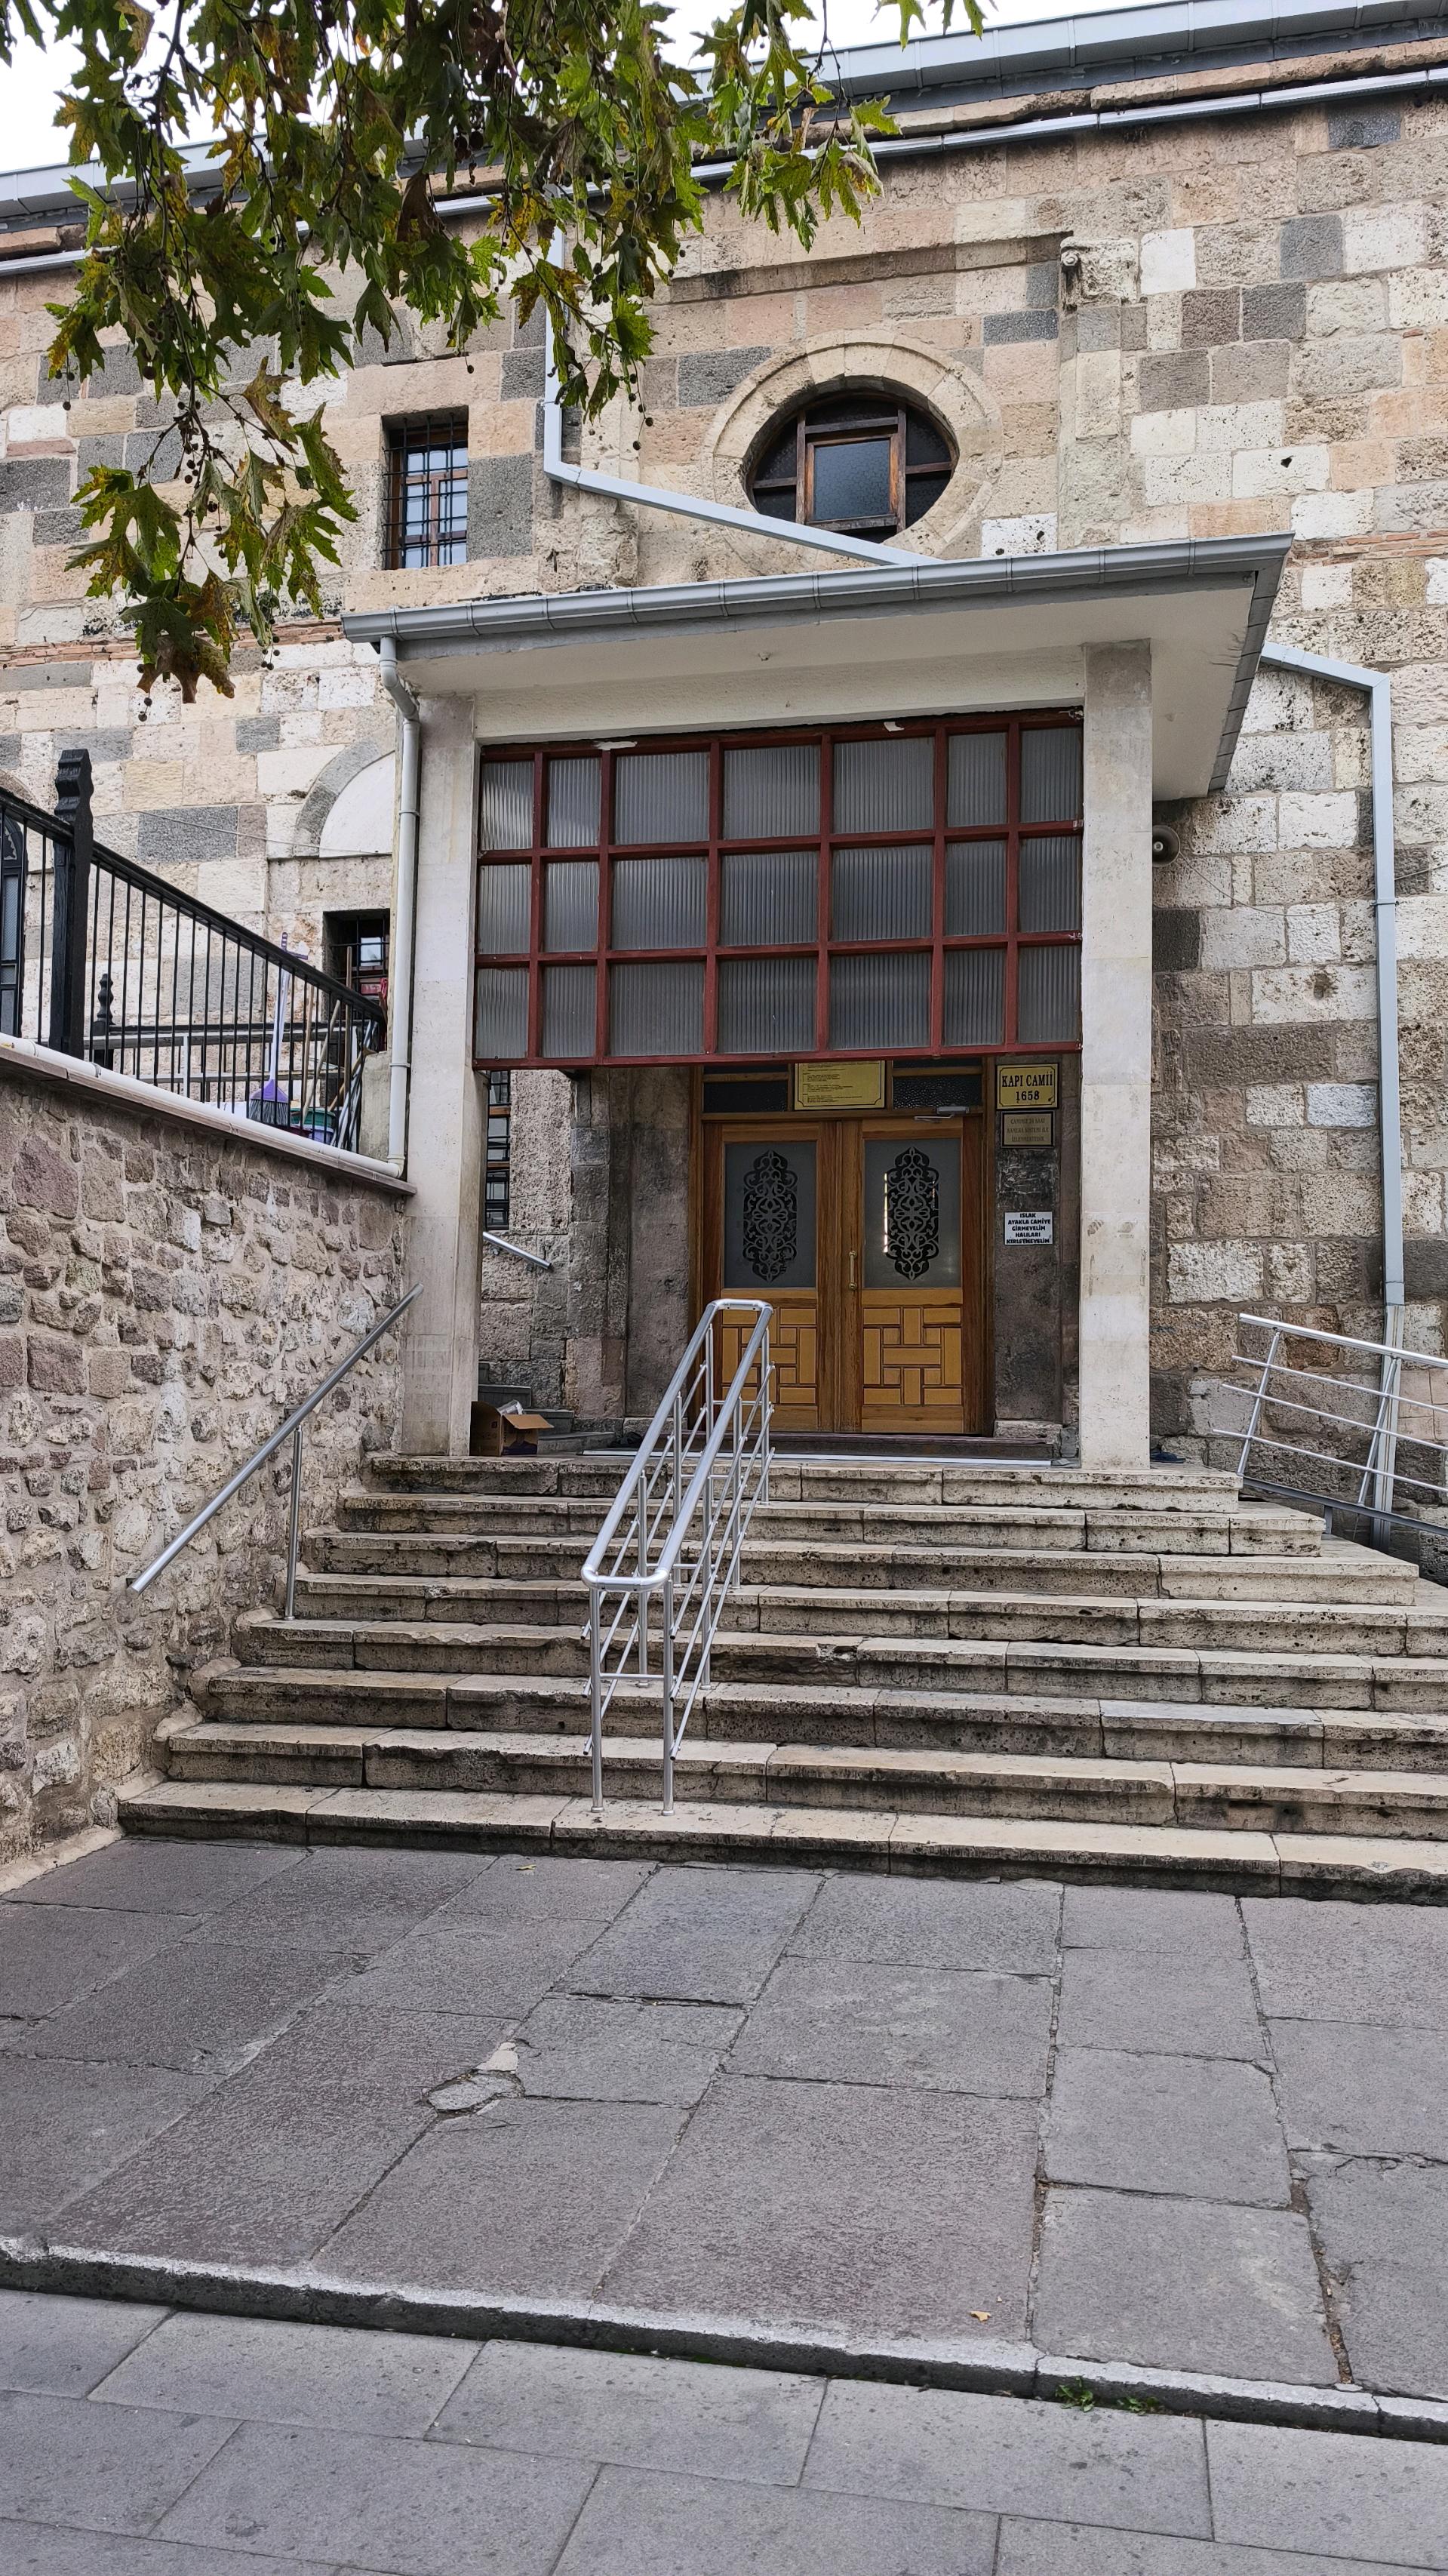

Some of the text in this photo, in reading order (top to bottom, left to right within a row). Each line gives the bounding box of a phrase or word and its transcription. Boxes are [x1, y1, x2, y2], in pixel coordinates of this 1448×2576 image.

[1002, 1071, 1053, 1087] KAPI CAMİİ
[1016, 1090, 1040, 1100] 1658
